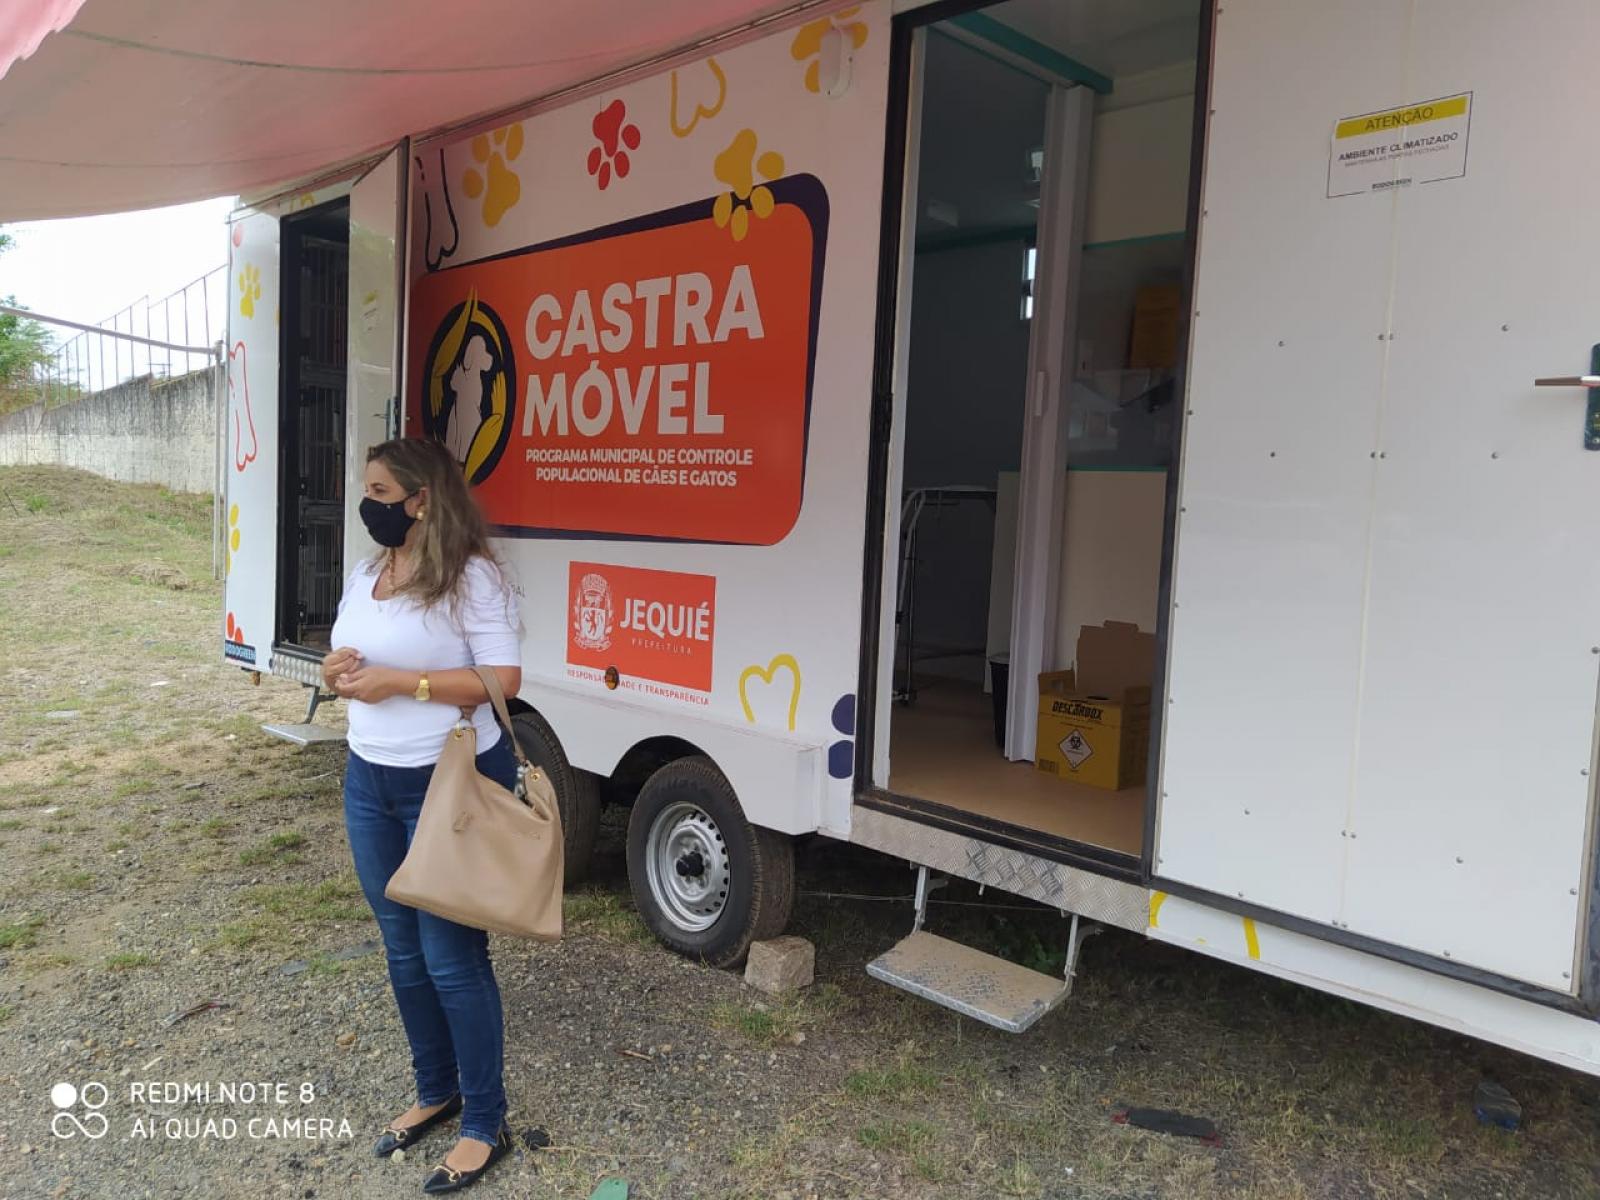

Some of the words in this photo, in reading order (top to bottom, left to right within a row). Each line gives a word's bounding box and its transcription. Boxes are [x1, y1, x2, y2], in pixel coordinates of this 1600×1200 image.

[1365, 107, 1434, 130] ATENÇÃO
[1338, 144, 1388, 161] AMBIENTE
[1390, 132, 1459, 152] CLIMATIZADO
[525, 264, 765, 360] CASTRA
[522, 360, 725, 437] MÓVEL
[525, 448, 588, 463] PROGRAMA
[590, 448, 656, 464] MUNICIPAL
[658, 449, 676, 465] DE
[677, 448, 753, 466] CONTROLE
[535, 467, 622, 483] POPULACIONAL
[624, 468, 641, 484] DE
[642, 464, 678, 485] CÃES
[680, 469, 689, 486] E
[690, 470, 737, 487] GATOS
[620, 597, 711, 642] JEQUIÉ
[631, 637, 693, 656] PREFEITURA
[1052, 700, 1104, 721] DESCARBOX
